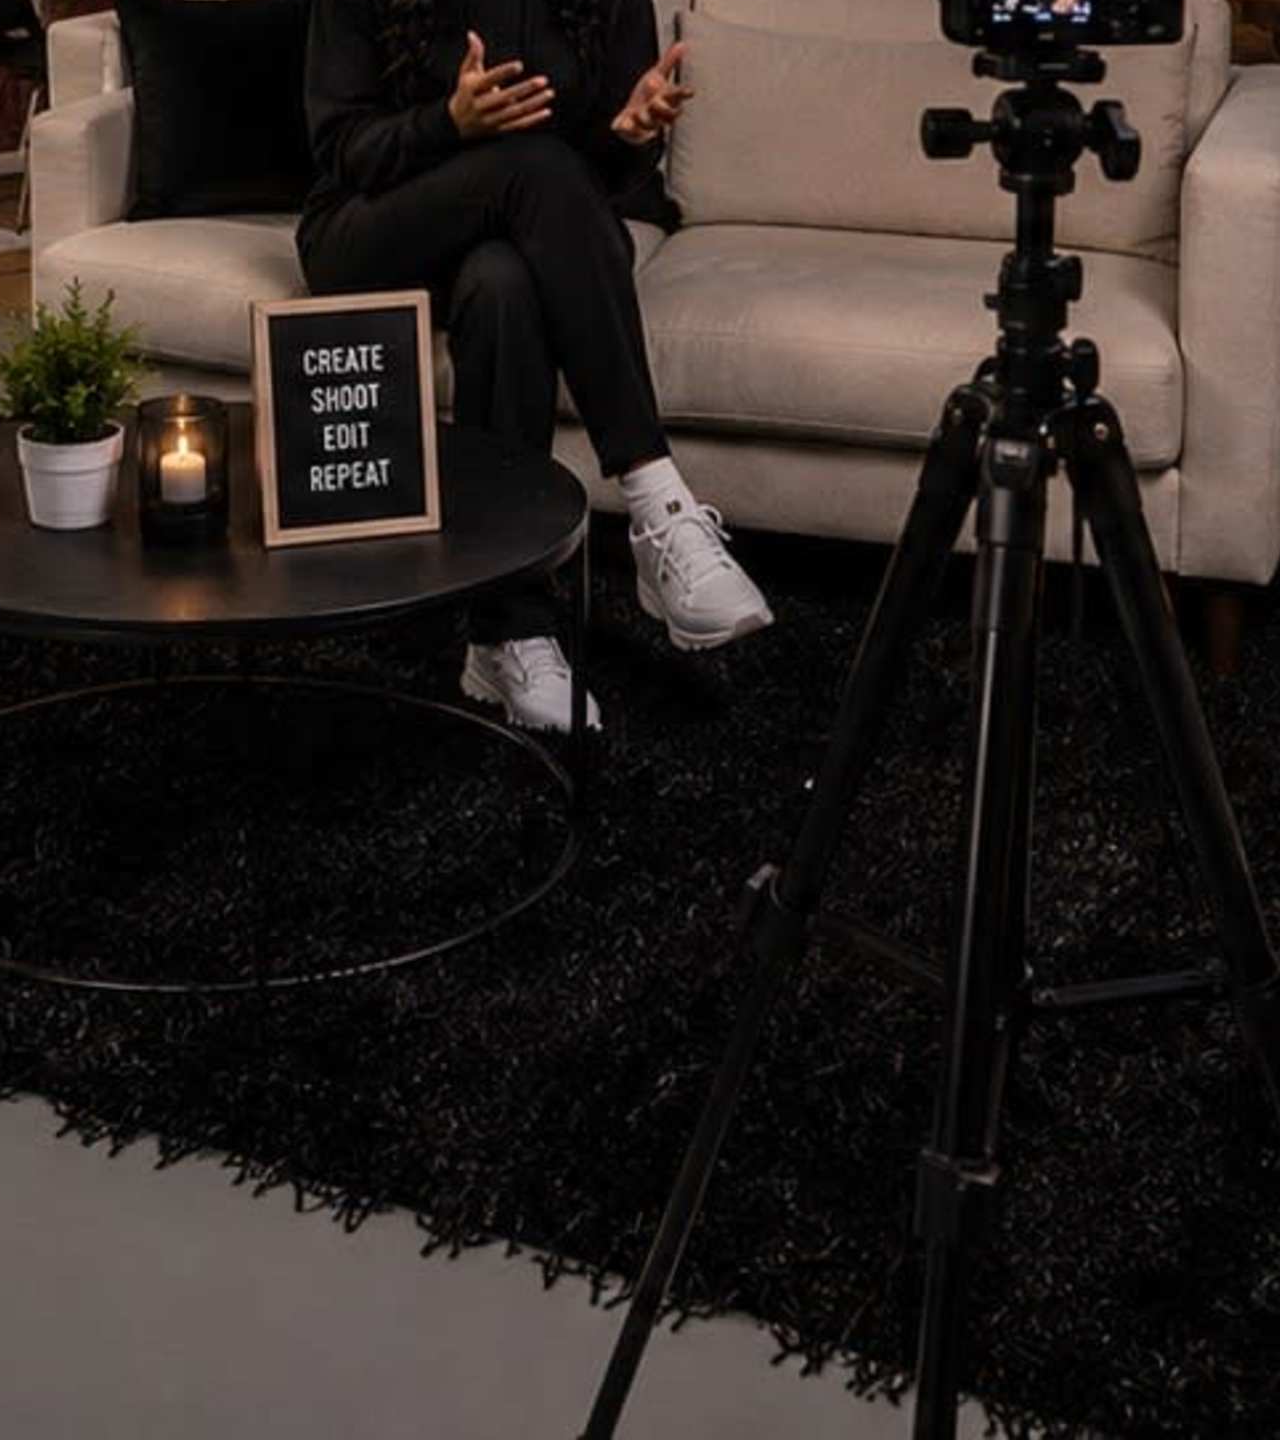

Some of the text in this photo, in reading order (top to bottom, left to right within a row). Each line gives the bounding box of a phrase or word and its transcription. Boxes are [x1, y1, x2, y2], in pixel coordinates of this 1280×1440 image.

[302, 344, 385, 377] CREATE
[310, 383, 380, 414] SHOOT
[322, 421, 371, 451] EDIT
[309, 458, 391, 492] REPEAT
